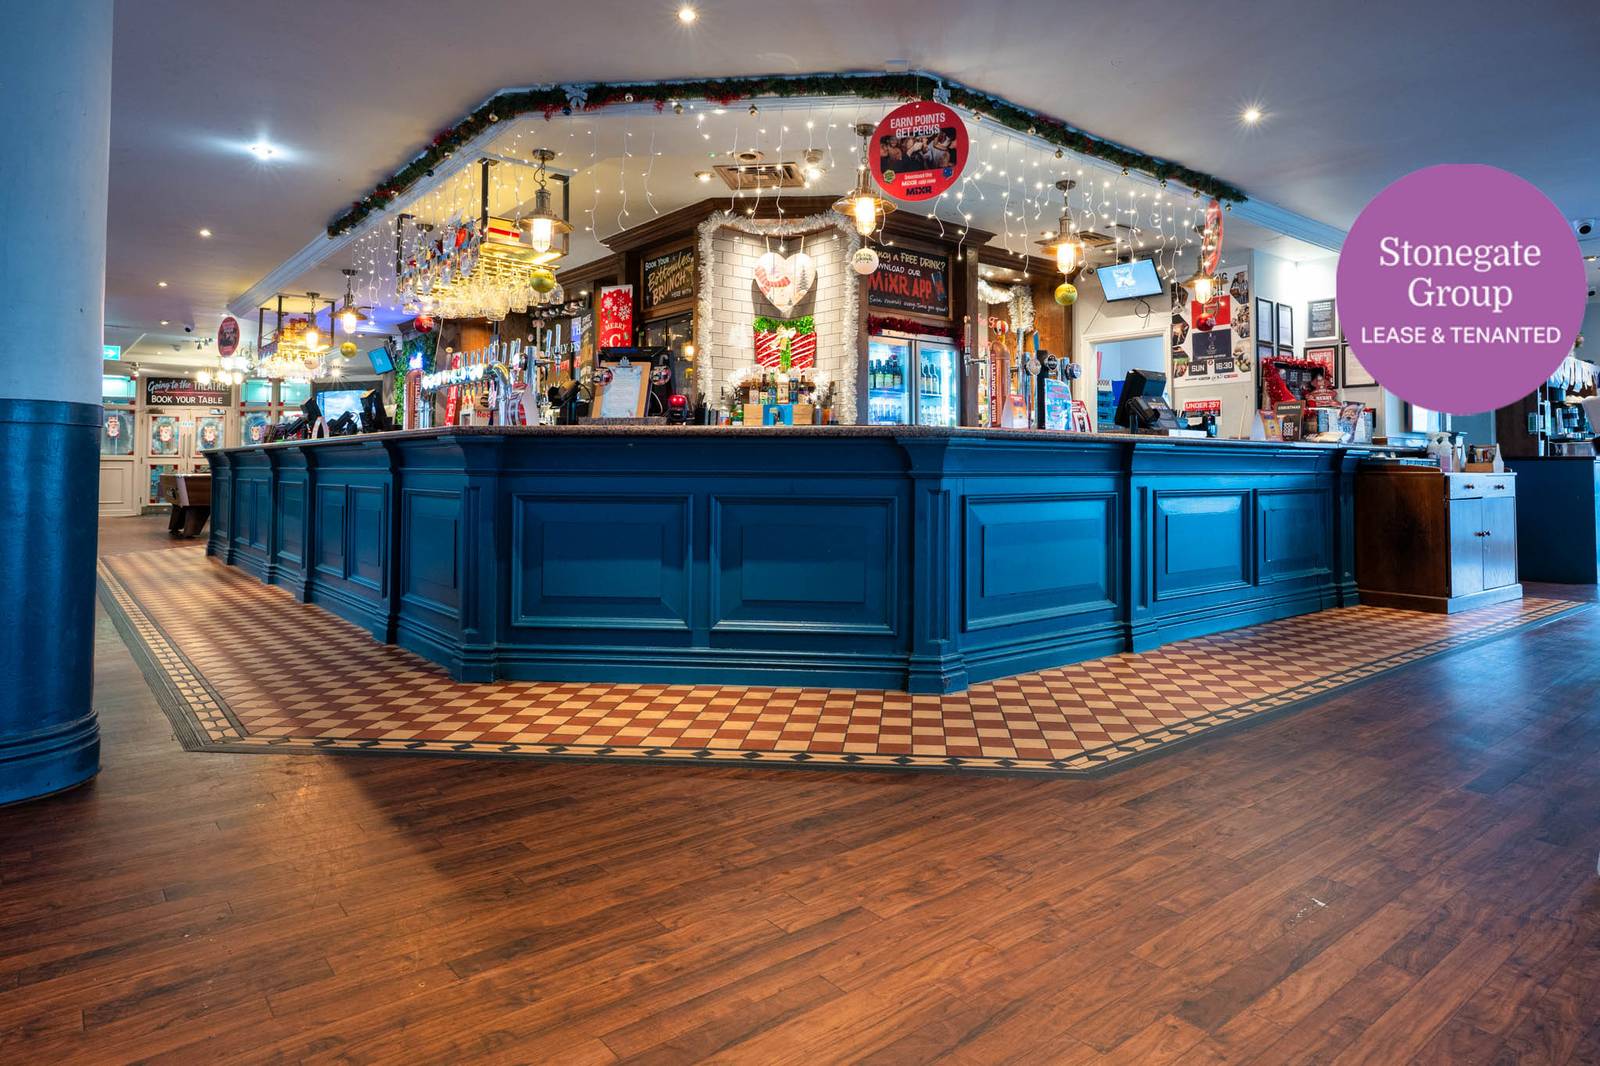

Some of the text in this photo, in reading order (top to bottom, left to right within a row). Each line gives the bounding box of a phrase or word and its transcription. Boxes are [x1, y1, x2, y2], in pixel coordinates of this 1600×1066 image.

[890, 112, 946, 129] EARN POINTS
[896, 123, 941, 139] GET PERKS
[900, 252, 919, 265] FREE
[919, 257, 946, 272] DRINK?
[908, 268, 921, 277] OUR
[652, 270, 686, 306] BRUNCH
[911, 278, 932, 300] APP
[605, 322, 626, 332] MERRY
[1191, 364, 1205, 374] SUN
[148, 381, 170, 394] Going
[171, 380, 179, 389] to
[179, 379, 192, 389] the
[151, 395, 223, 405] BOOK YOUR TABLE
[1185, 401, 1208, 410] UNDER
